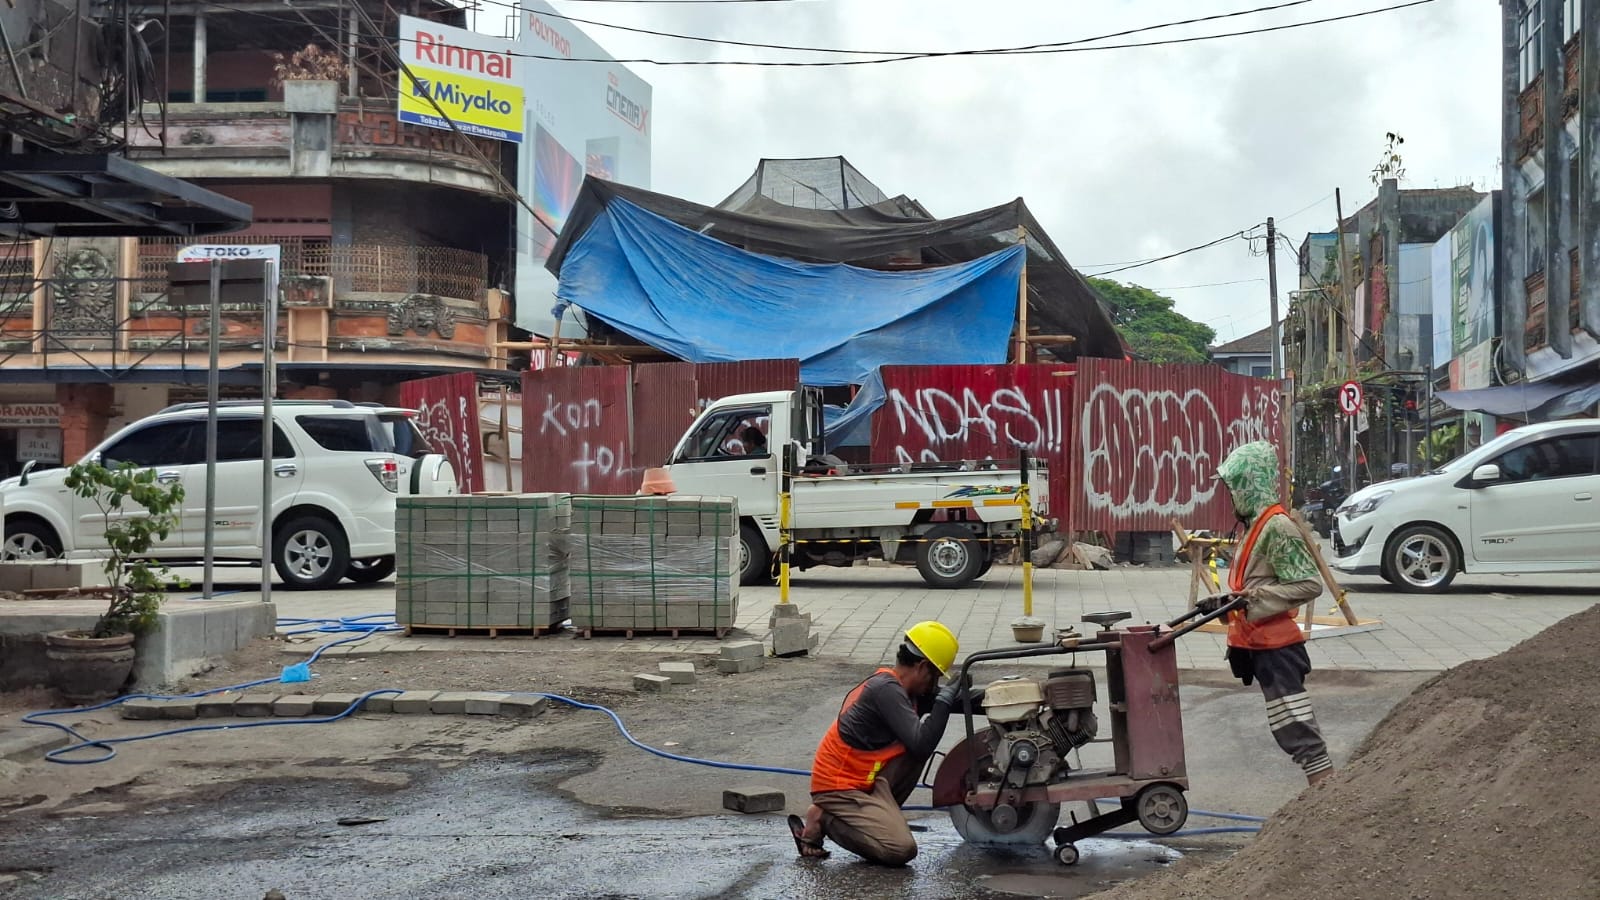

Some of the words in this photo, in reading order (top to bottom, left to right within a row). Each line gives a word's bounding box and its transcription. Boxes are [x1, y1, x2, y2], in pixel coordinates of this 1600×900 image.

[529, 13, 571, 57] POLYTRON
[416, 31, 512, 79] Rinnai
[434, 81, 512, 115] Miyako
[204, 247, 250, 257] TOKO
[0, 406, 59, 417] RAWAN
[1346, 387, 1356, 409] P
